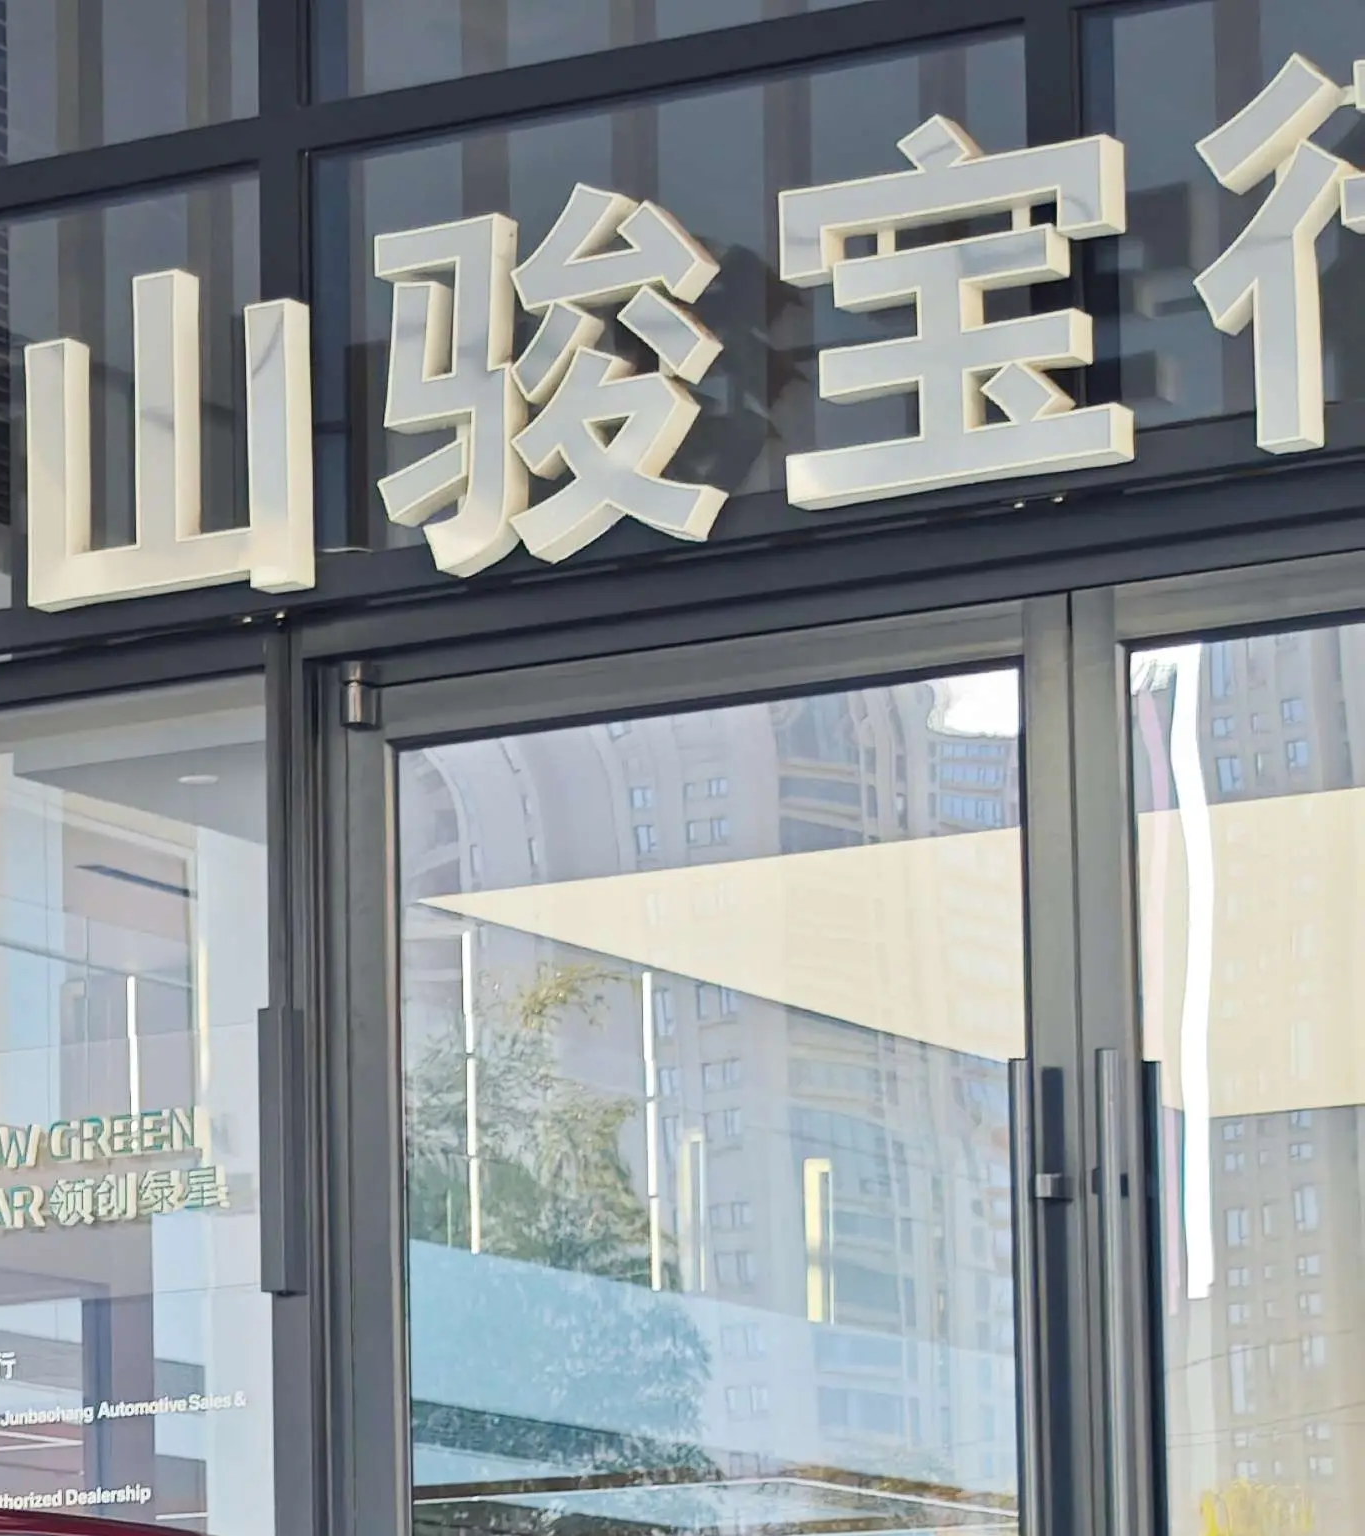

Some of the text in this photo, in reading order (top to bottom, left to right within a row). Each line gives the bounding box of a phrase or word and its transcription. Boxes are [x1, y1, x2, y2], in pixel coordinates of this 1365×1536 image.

[49, 1105, 211, 1164] GREEN
[49, 1164, 231, 1227] 领创绿星
[97, 1394, 187, 1420] Automotive
[188, 1392, 232, 1411] Sales
[234, 1390, 247, 1408] &
[65, 1482, 152, 1506] Dealership
